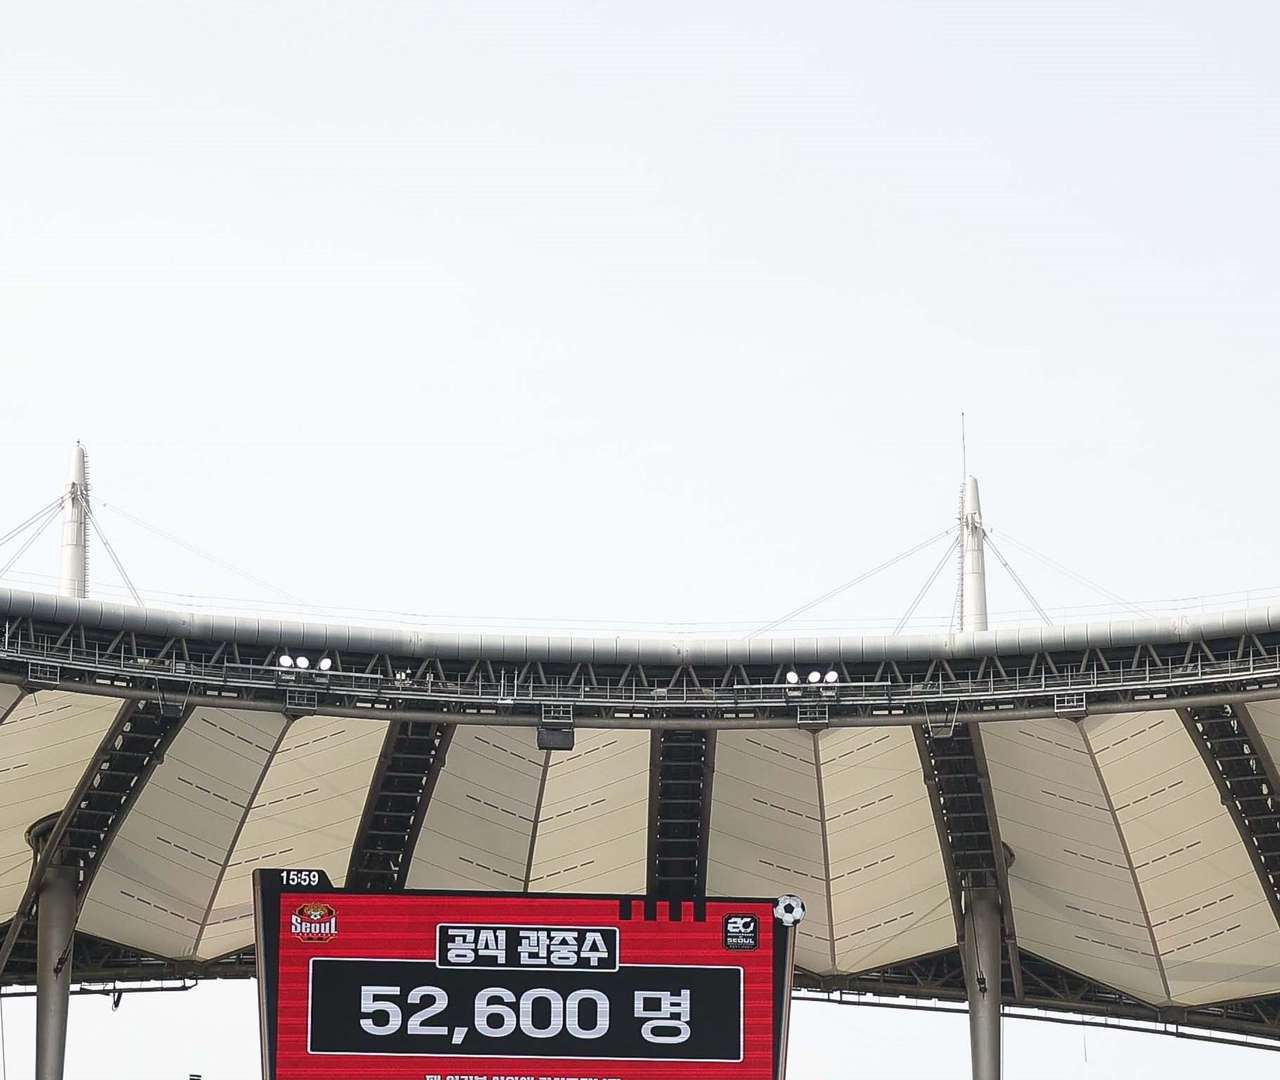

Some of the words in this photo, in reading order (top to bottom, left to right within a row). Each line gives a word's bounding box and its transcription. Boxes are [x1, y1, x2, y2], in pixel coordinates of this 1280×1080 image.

[280, 871, 319, 886] 15:59
[291, 914, 338, 935] Seoul
[447, 928, 506, 964] 공식
[518, 930, 609, 966] 관중수
[359, 986, 610, 1045] 52,600
[634, 989, 691, 1044] 명
